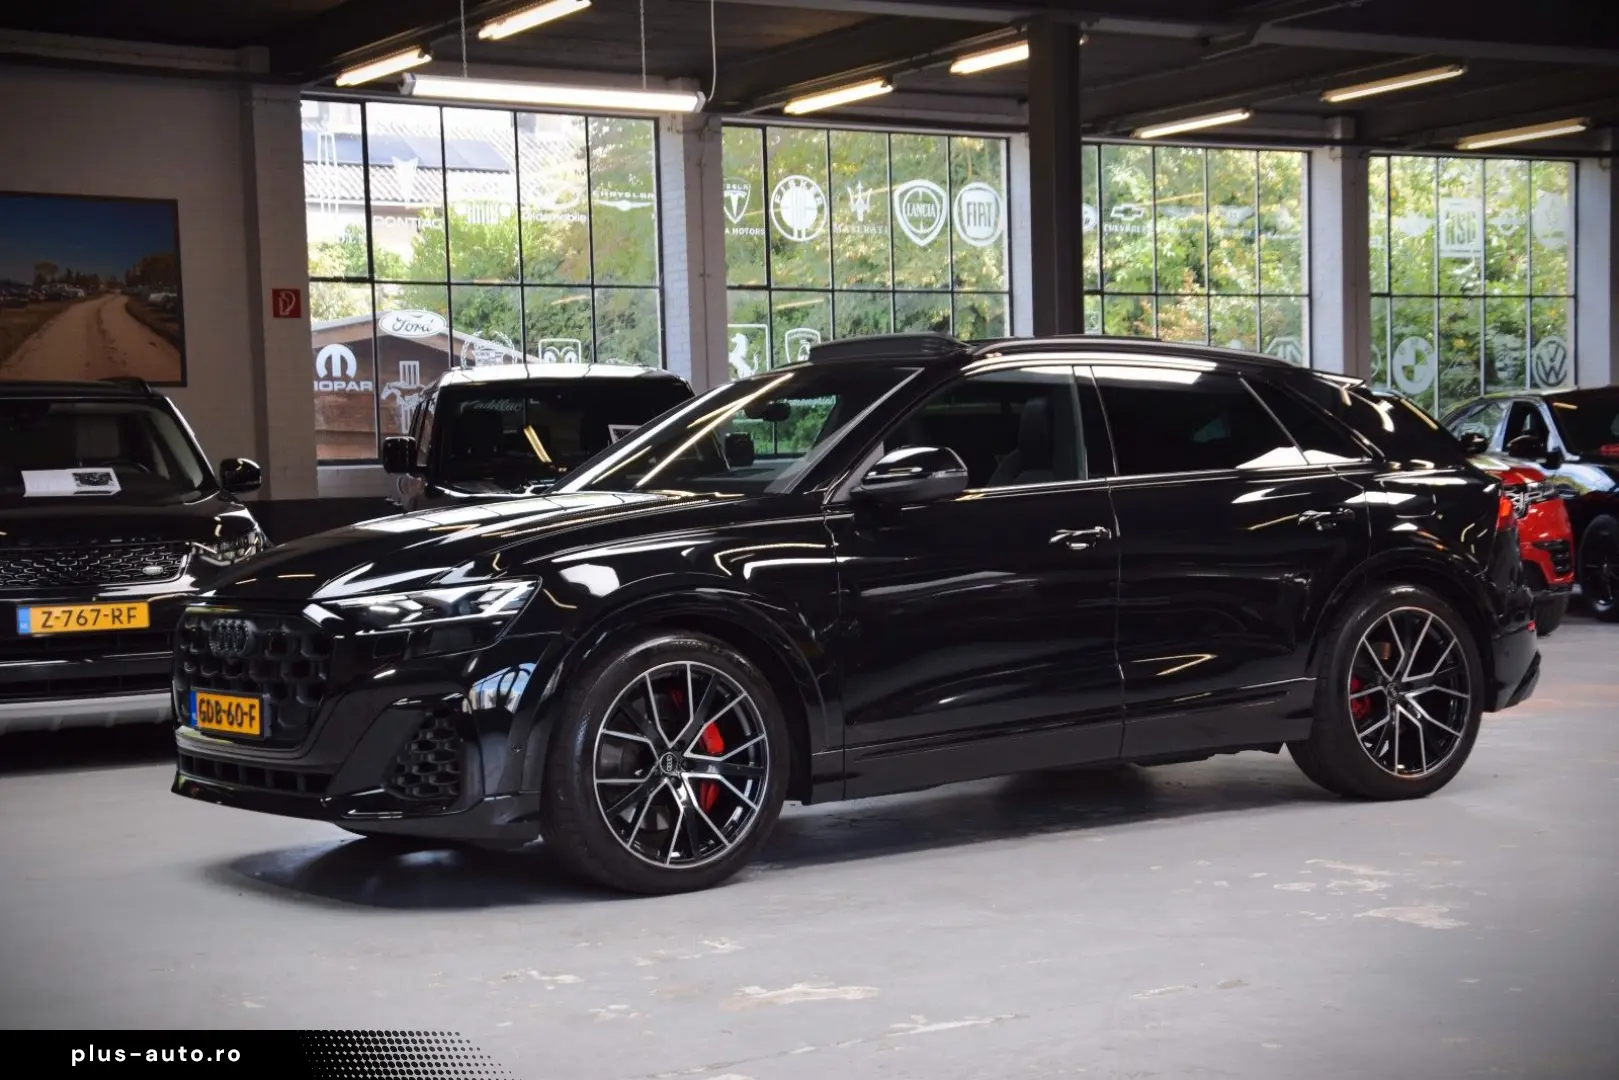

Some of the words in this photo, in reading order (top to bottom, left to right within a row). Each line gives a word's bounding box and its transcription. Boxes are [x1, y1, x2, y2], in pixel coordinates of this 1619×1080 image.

[907, 202, 937, 218] LANCIA
[966, 201, 994, 227] FIAT
[372, 215, 443, 229] PONTIAC
[732, 227, 765, 236] MOTORS
[391, 316, 436, 332] Ford
[41, 606, 138, 628] Z-767-RF
[199, 697, 257, 729] GDB-60-F
